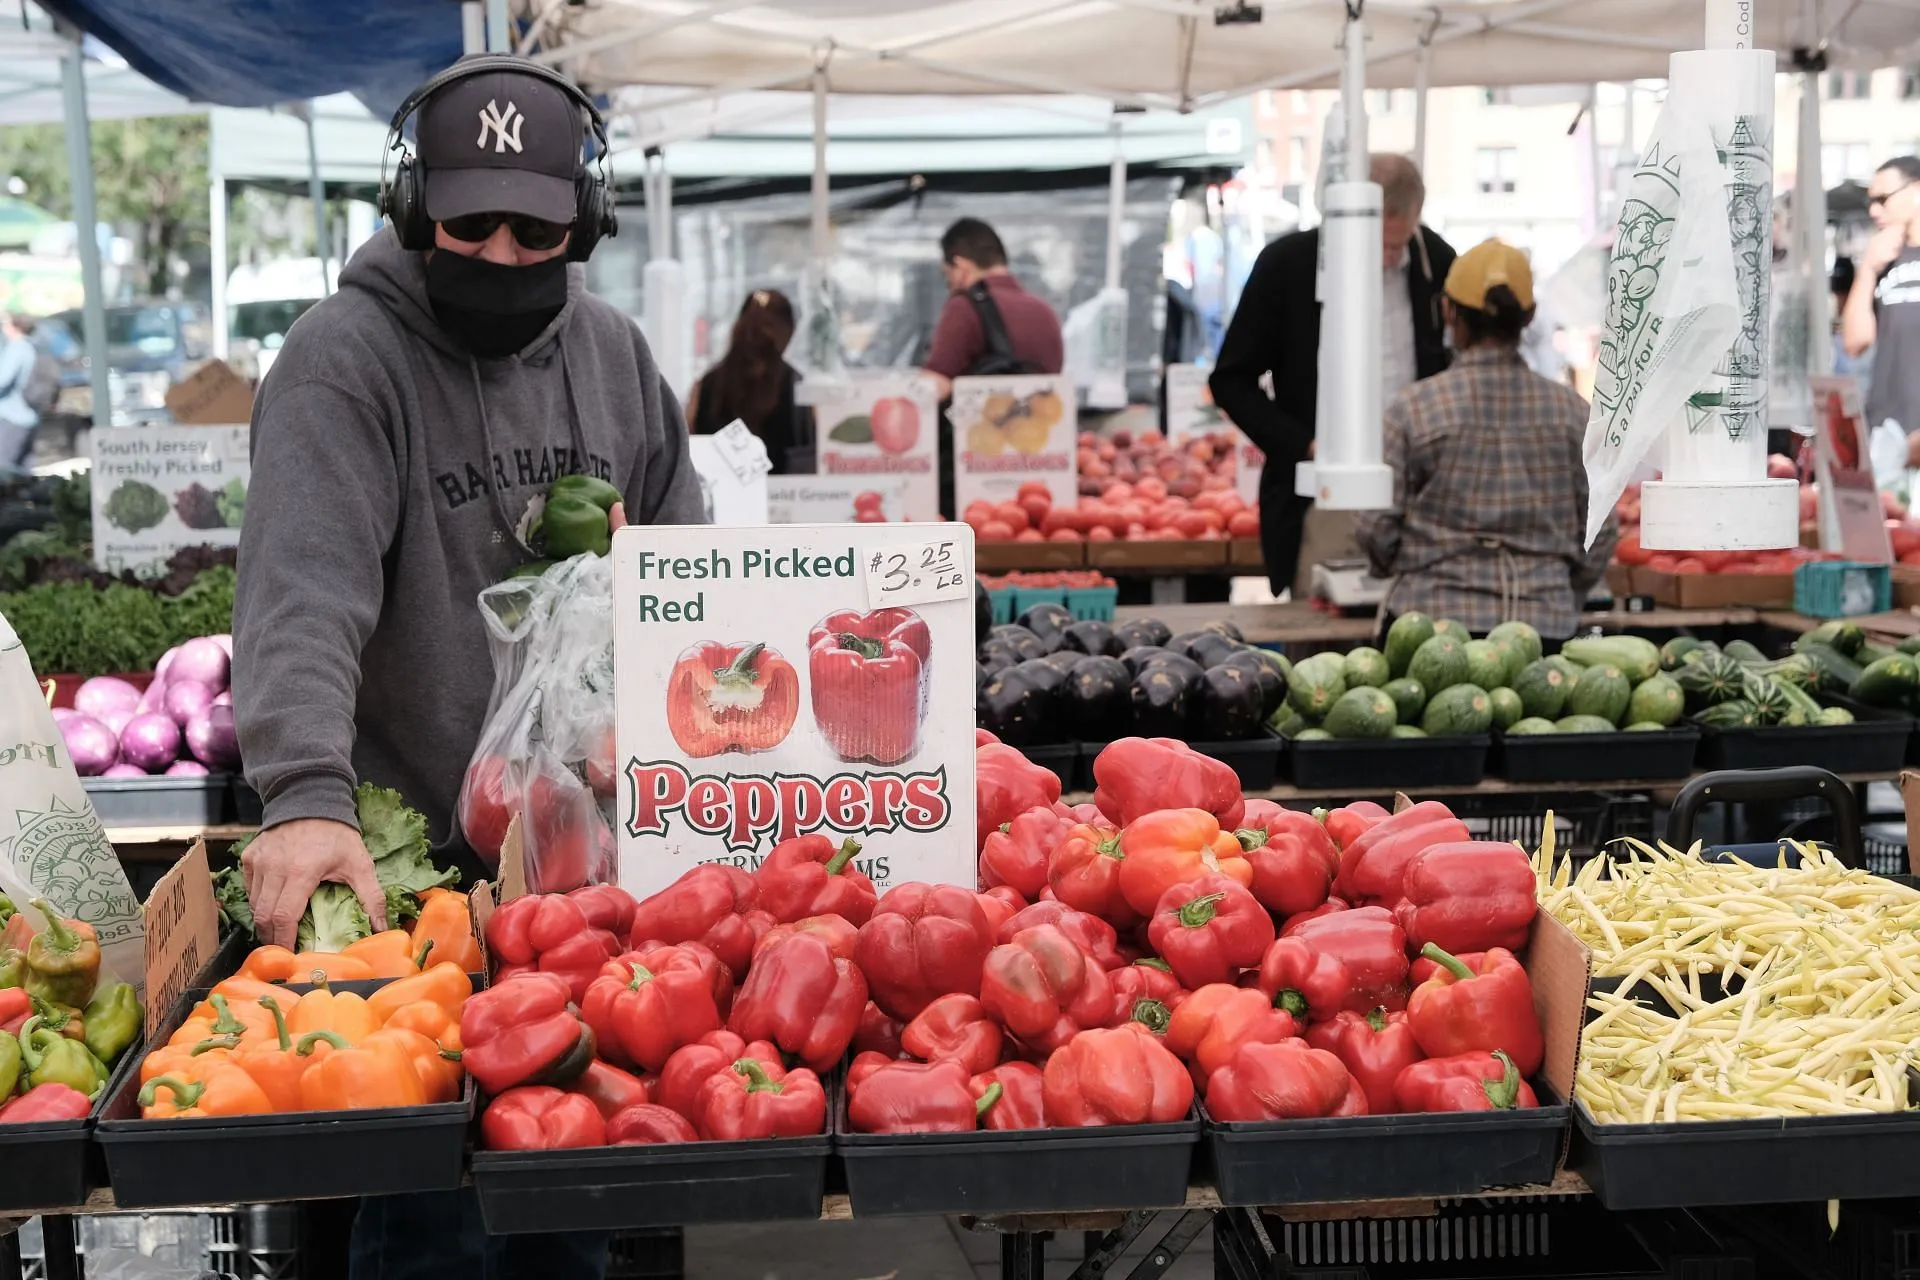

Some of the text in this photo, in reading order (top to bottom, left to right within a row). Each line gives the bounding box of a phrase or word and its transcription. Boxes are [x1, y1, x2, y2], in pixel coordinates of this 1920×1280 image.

[477, 99, 524, 153] NY
[1734, 159, 1745, 197] TEAR
[1611, 432, 1621, 447] 5
[1621, 418, 1629, 432] a
[1729, 401, 1741, 439] TEAR
[98, 439, 208, 456] South Jersey
[99, 459, 222, 478] Freshly Picked
[768, 485, 796, 501] ield
[639, 547, 855, 580] Fresh Picked
[936, 573, 963, 590] LB
[639, 592, 704, 623] Red
[625, 756, 952, 853] Peppers
